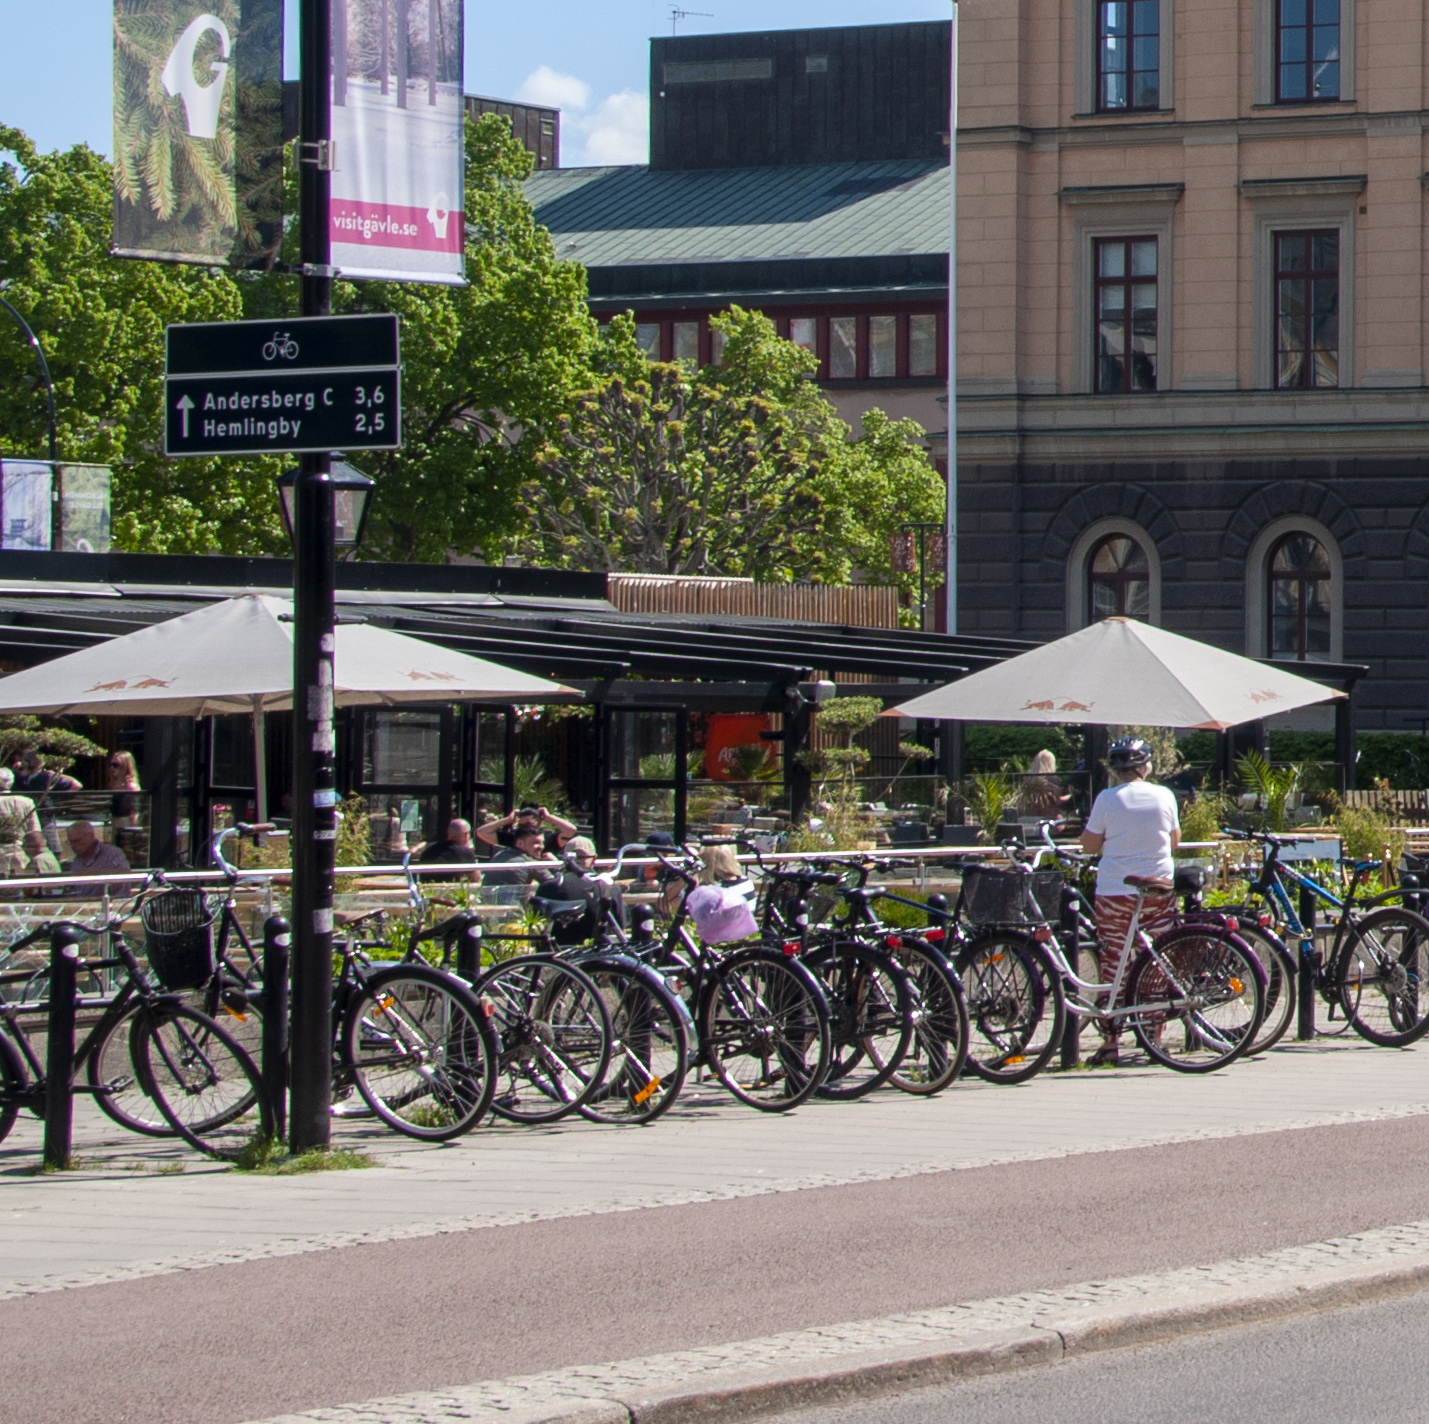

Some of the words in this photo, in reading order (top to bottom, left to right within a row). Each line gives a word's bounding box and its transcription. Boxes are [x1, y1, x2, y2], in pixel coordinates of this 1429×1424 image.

[333, 210, 418, 239] visitgävle.se
[203, 390, 315, 411] Andersberg
[323, 388, 334, 406] C
[354, 385, 385, 408] 3,6
[203, 416, 302, 439] Hemlingby
[354, 412, 385, 435] 2,5
